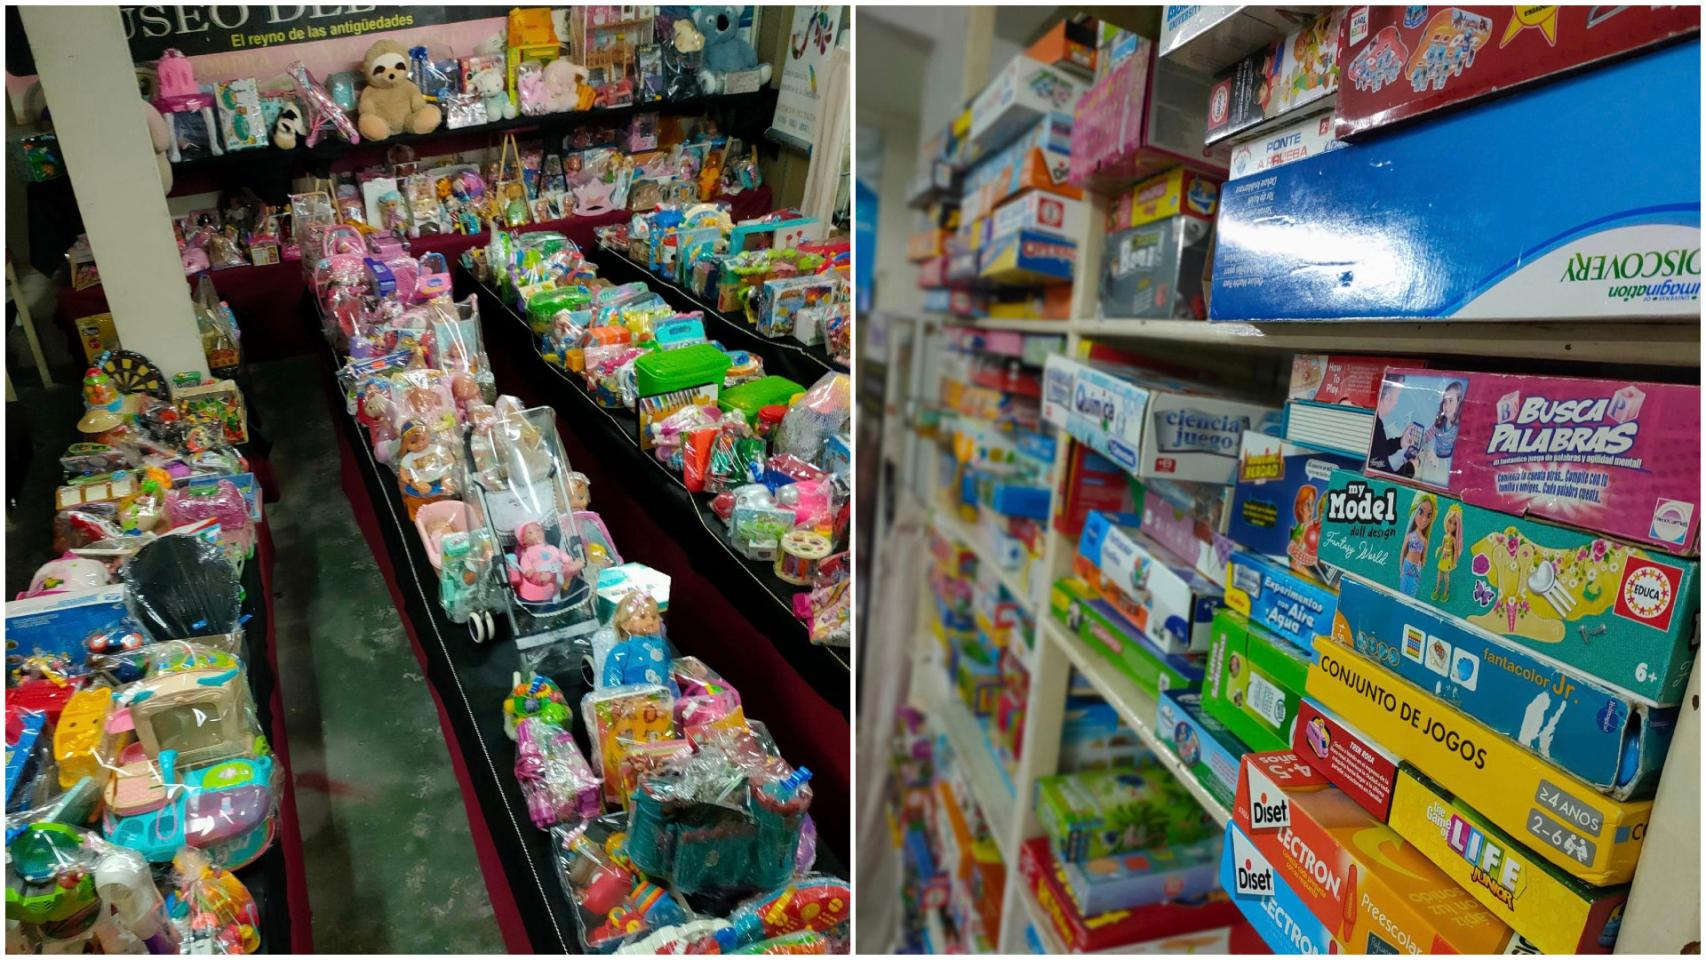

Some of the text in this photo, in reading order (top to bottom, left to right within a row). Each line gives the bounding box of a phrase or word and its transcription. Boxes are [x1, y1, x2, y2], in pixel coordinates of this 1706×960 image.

[231, 34, 245, 47] El
[250, 33, 286, 47] reyno
[289, 28, 304, 41] de
[308, 25, 327, 38] las
[330, 14, 414, 36] antigüedades
[1266, 132, 1301, 153] PONTE
[1257, 160, 1265, 170] A
[1608, 279, 1701, 302] imagination
[1328, 363, 1343, 372] How
[1333, 374, 1340, 384] To
[1326, 384, 1339, 396] Play
[1166, 410, 1241, 434] ciencia
[1518, 397, 1608, 424] BUSCA
[1174, 427, 1234, 450] juego
[1487, 422, 1639, 454] PALABRAS
[1554, 453, 1581, 462] palabras
[1586, 455, 1615, 465] agilidad
[1565, 469, 1589, 484] Compite
[1589, 471, 1602, 485] con
[1348, 484, 1366, 498] my
[1328, 491, 1395, 521] Model
[1350, 525, 1397, 540] doll design
[1323, 531, 1390, 566] Fantasy World
[1265, 576, 1323, 612] Experimentos
[1633, 584, 1660, 601] EDUCA
[1288, 603, 1315, 628] Aire
[1483, 647, 1580, 705] fantacolor Jr.
[1634, 662, 1658, 683] 6+
[1321, 655, 1397, 713] CONJUNTO
[1400, 701, 1422, 729] DE
[1422, 717, 1488, 770] JOGOS
[1258, 753, 1297, 765] años
[1254, 796, 1288, 824] Diset
[1427, 806, 1452, 830] Game
[1559, 801, 1600, 832] ANOS
[1440, 827, 1450, 841] of
[1450, 818, 1521, 891] LIFE
[1238, 865, 1272, 891] Diset
[1470, 865, 1515, 912] JUNIOR
[1361, 893, 1423, 955] Preescolar
